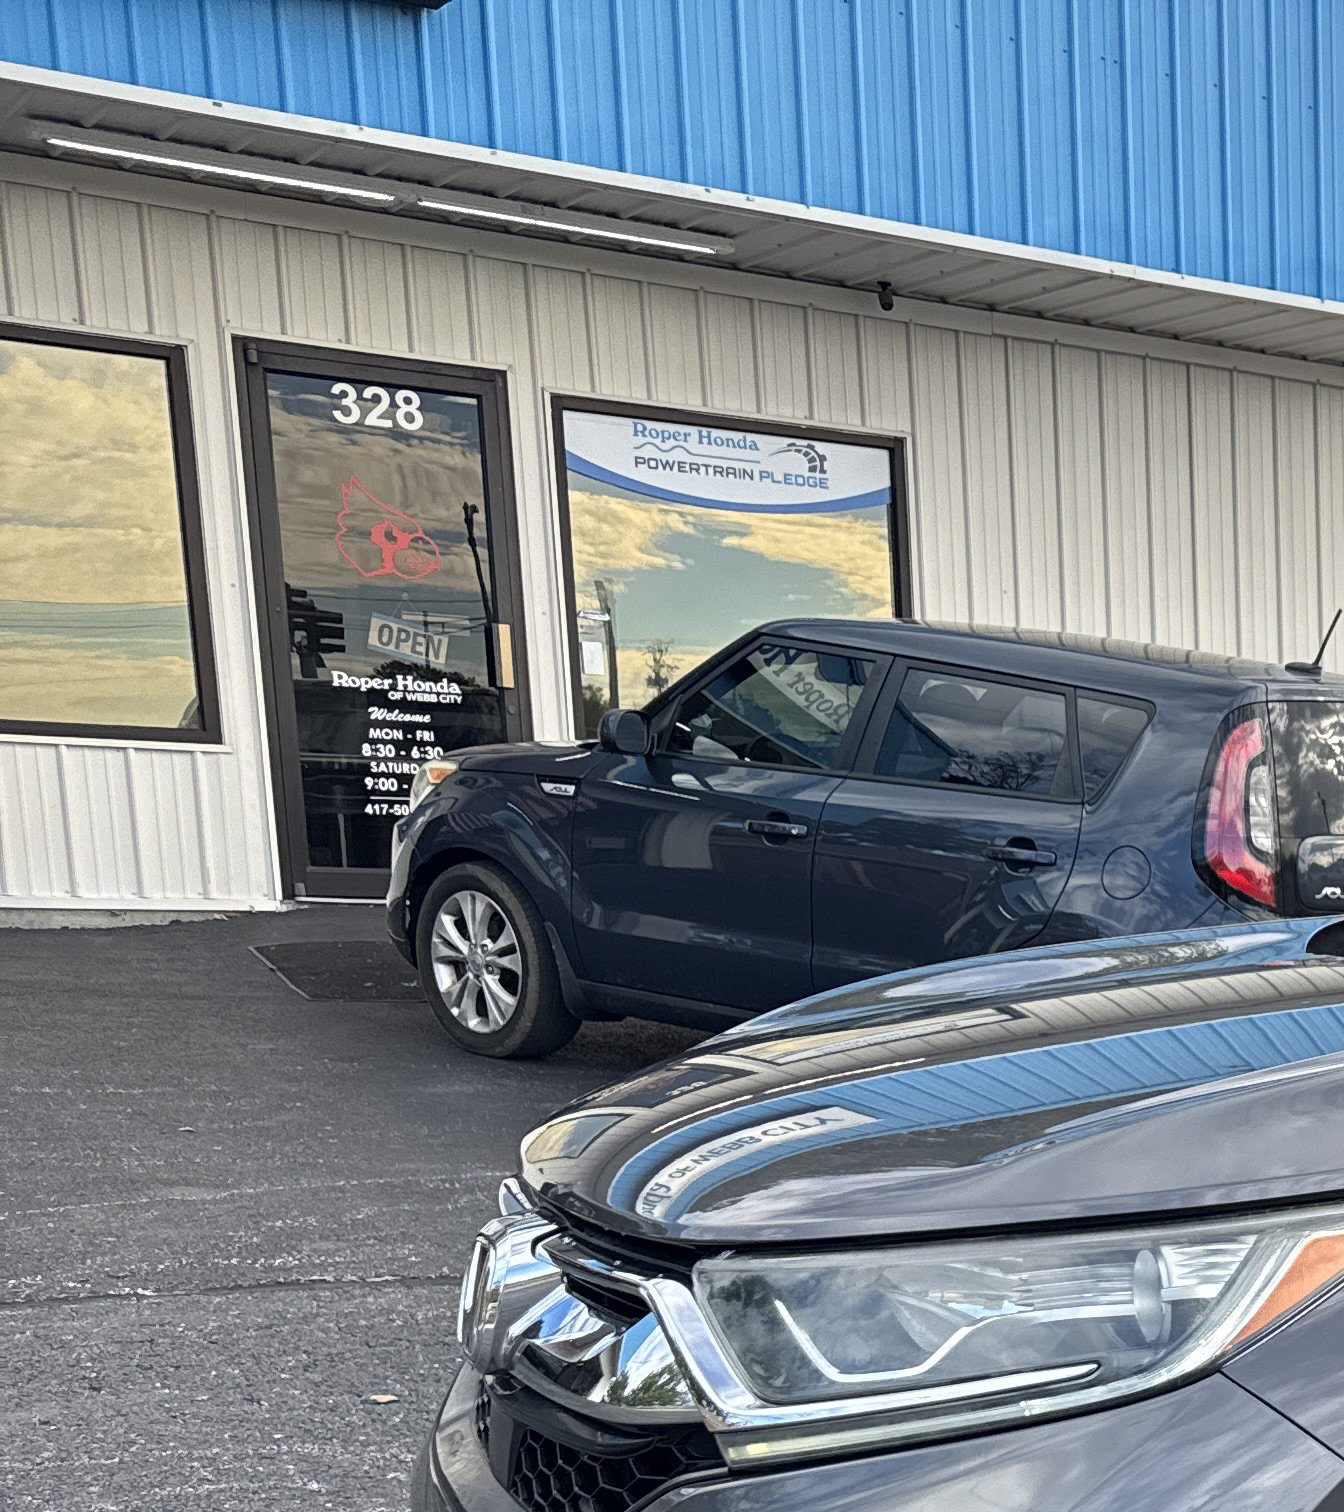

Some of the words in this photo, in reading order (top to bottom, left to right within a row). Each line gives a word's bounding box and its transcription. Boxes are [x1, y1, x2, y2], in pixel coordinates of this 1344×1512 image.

[329, 381, 425, 431] 328
[632, 421, 691, 443] Roper
[697, 429, 759, 451] Honda
[634, 456, 754, 481] POWERTRAIN
[759, 470, 829, 489] PLEDGE
[377, 623, 444, 661] OPEN
[331, 670, 392, 691] Roper
[396, 675, 462, 694] Honda
[388, 691, 404, 701] OF
[405, 692, 438, 702] WEBB
[439, 694, 463, 704] CITY
[368, 706, 431, 723] Welcome
[369, 728, 403, 740] MON
[416, 730, 435, 741] FRI
[362, 743, 395, 757] 8:30
[411, 746, 444, 760] 6:30
[370, 761, 420, 775] SATURD
[364, 777, 398, 791] 9:00
[364, 804, 410, 816] 417-50
